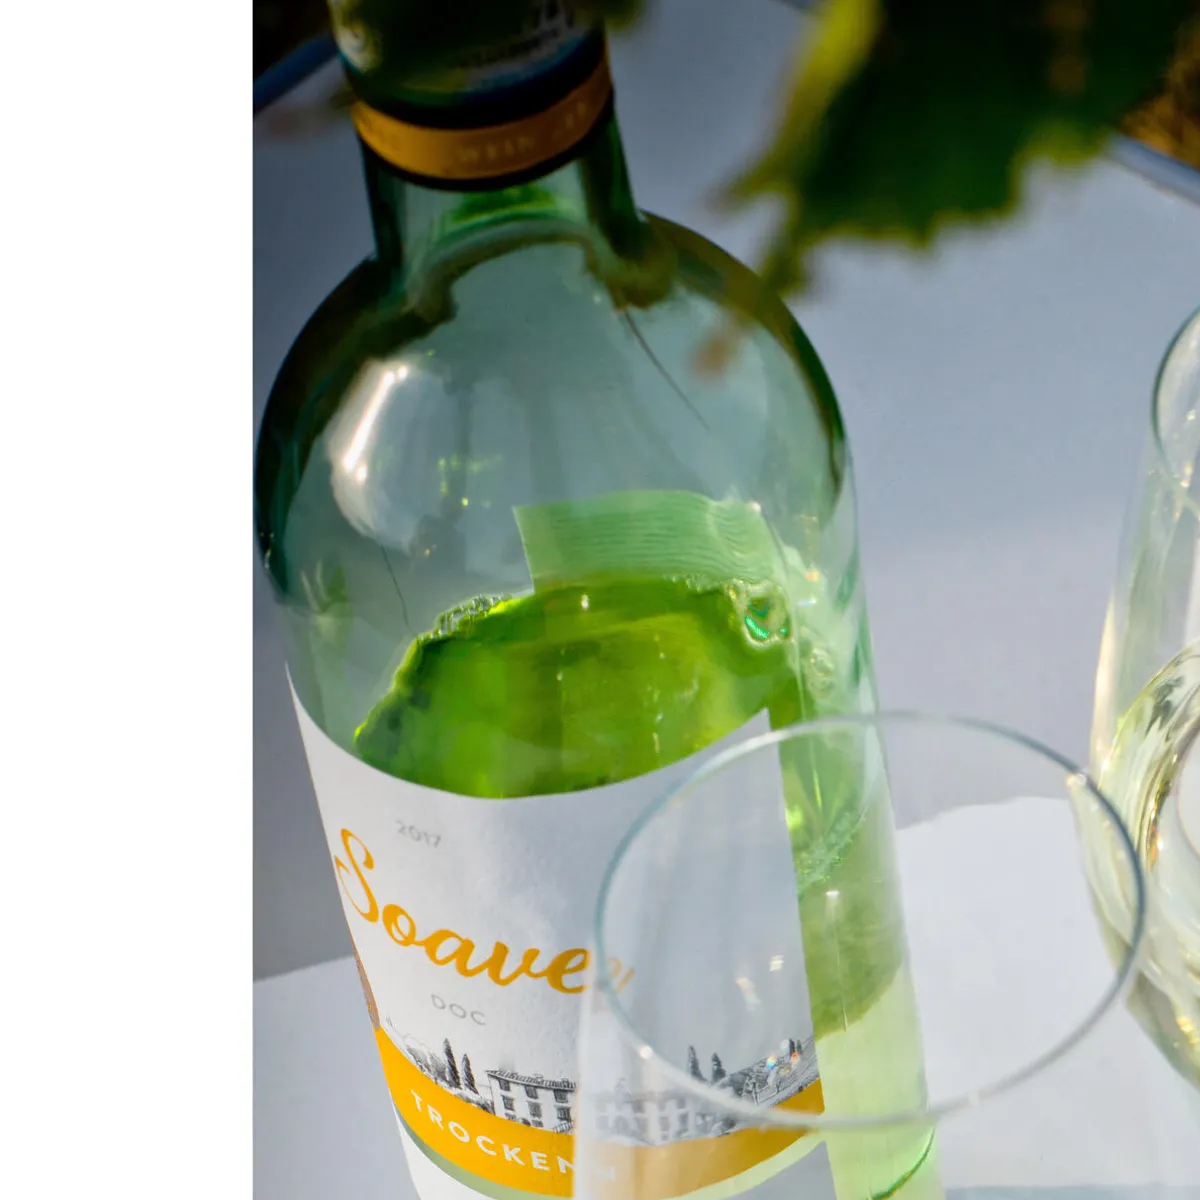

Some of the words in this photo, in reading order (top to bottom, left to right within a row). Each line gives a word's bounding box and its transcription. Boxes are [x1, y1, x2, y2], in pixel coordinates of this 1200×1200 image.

[396, 819, 442, 849] 2017
[334, 827, 591, 995] Soave
[430, 993, 487, 1026] DOC
